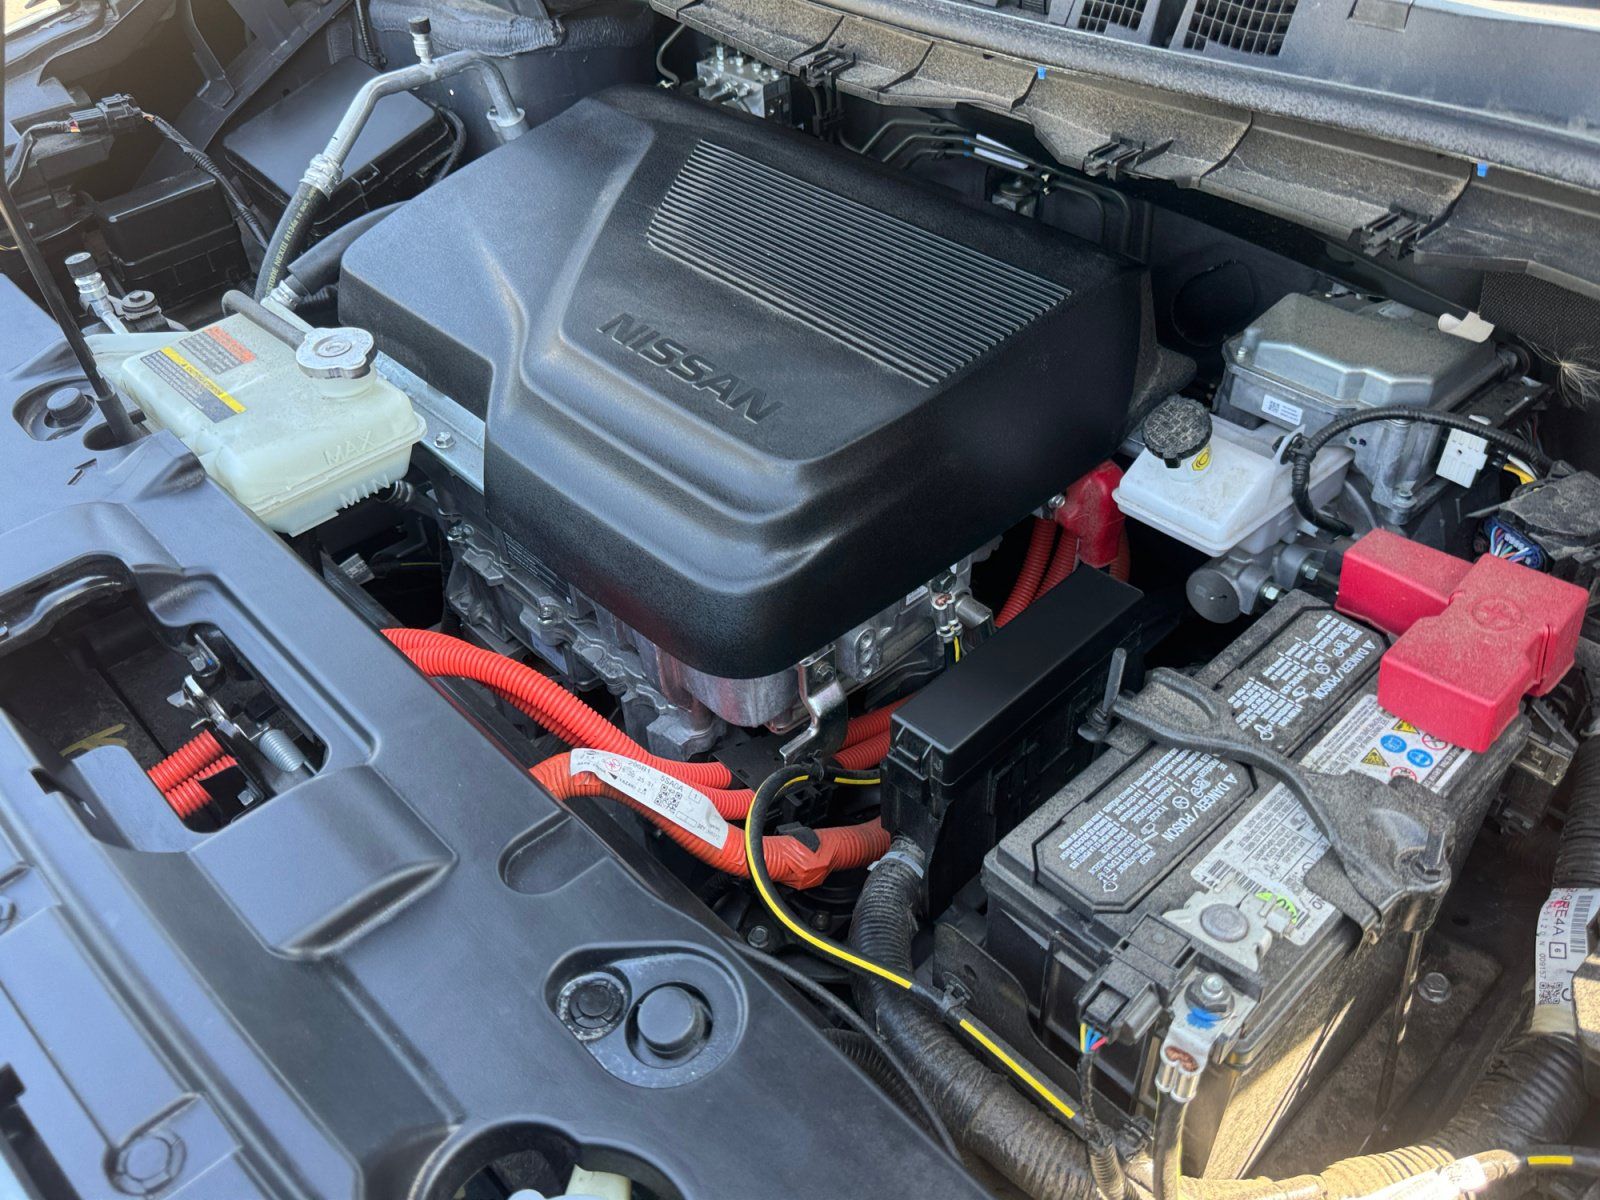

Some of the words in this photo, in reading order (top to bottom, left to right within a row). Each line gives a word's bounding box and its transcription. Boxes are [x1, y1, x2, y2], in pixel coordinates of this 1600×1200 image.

[596, 312, 785, 424] NISSAN
[321, 429, 376, 466] MAX
[340, 473, 391, 509] MIN
[1341, 647, 1371, 673] DANGER
[1311, 674, 1341, 700] POISON
[1195, 781, 1231, 812] DANGER
[1161, 812, 1196, 842] POISON
